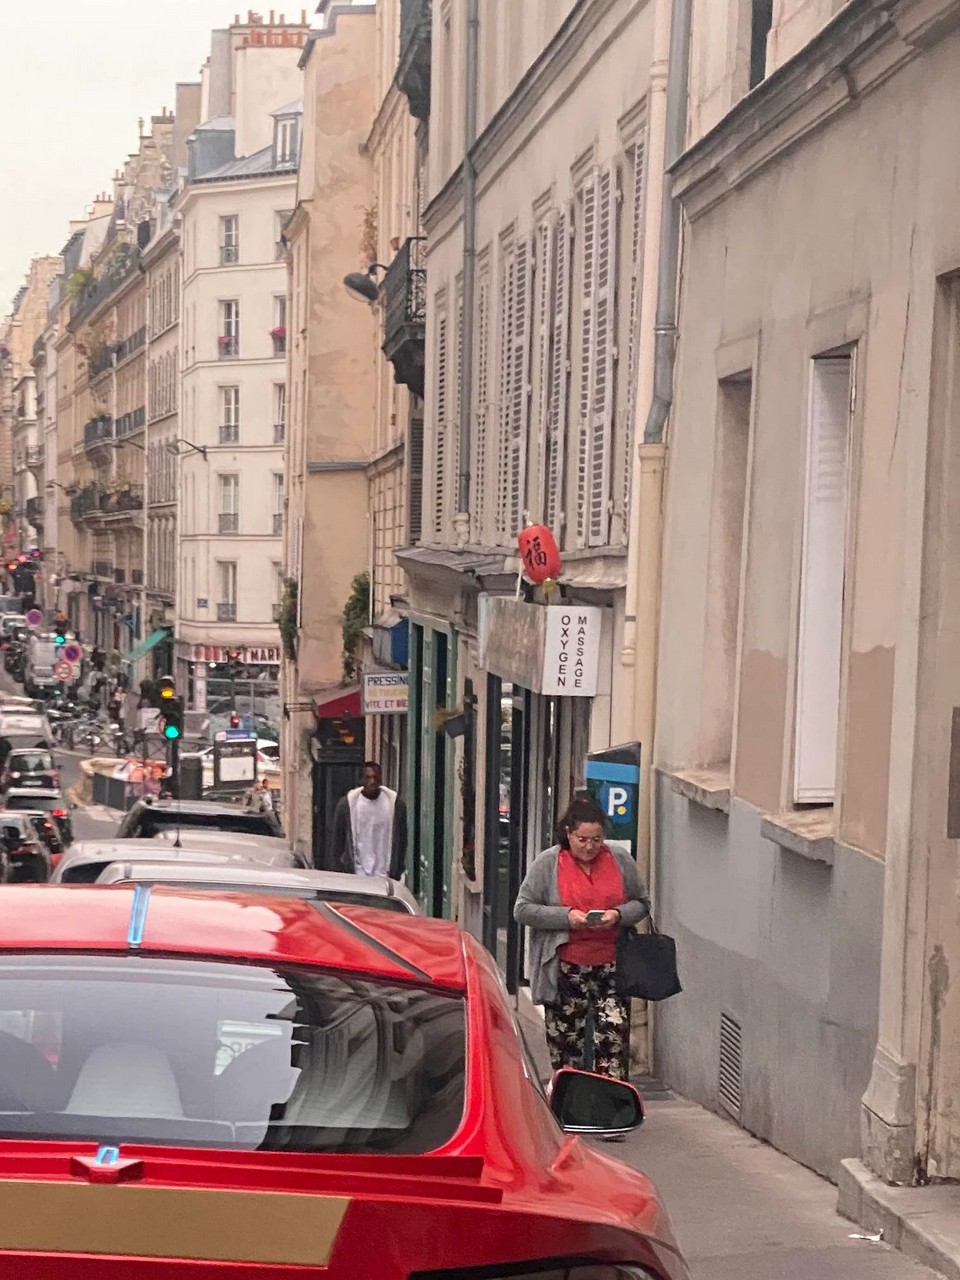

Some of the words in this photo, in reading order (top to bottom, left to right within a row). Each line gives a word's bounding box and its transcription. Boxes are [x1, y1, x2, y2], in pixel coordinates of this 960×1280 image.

[526, 536, 547, 570] 福
[557, 615, 571, 687] OXYGEN
[574, 616, 587, 688] MASSAGE
[385, 700, 395, 708] ET
[608, 787, 628, 816] P
